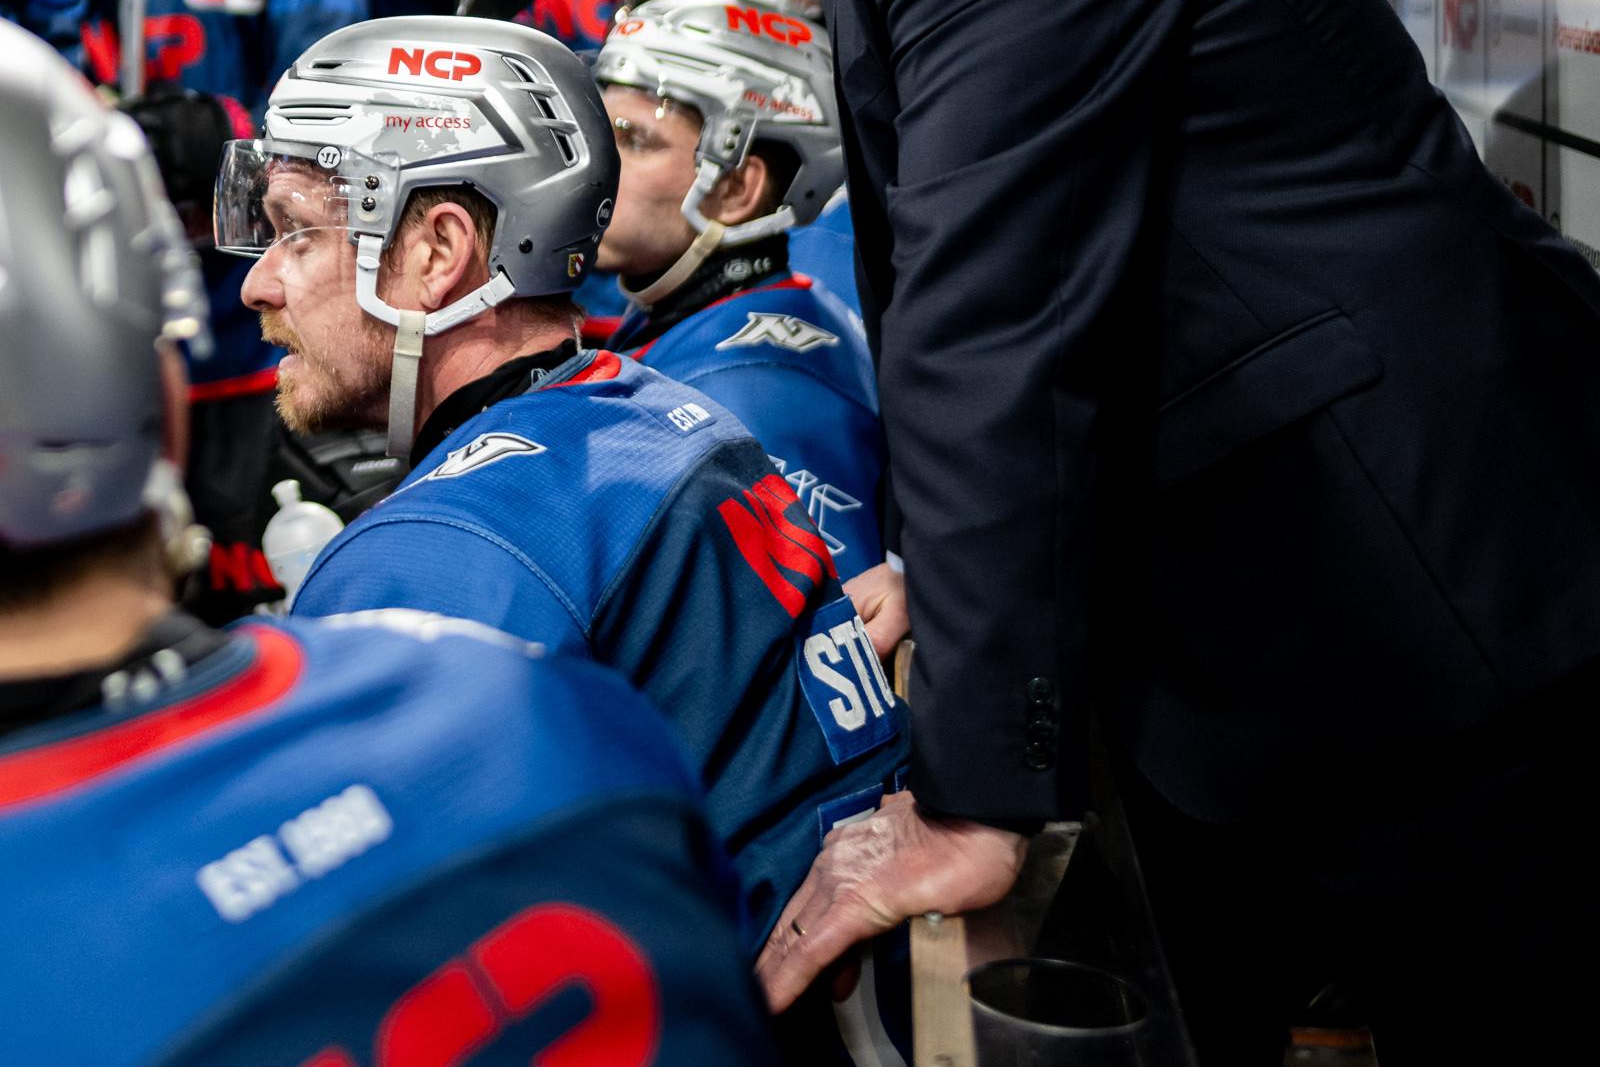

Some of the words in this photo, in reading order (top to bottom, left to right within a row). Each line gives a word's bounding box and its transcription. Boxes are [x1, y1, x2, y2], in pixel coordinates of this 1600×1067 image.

[724, 5, 813, 48] NCP
[387, 47, 482, 82] NCP
[744, 90, 765, 106] my
[386, 116, 412, 133] my
[415, 116, 471, 129] access
